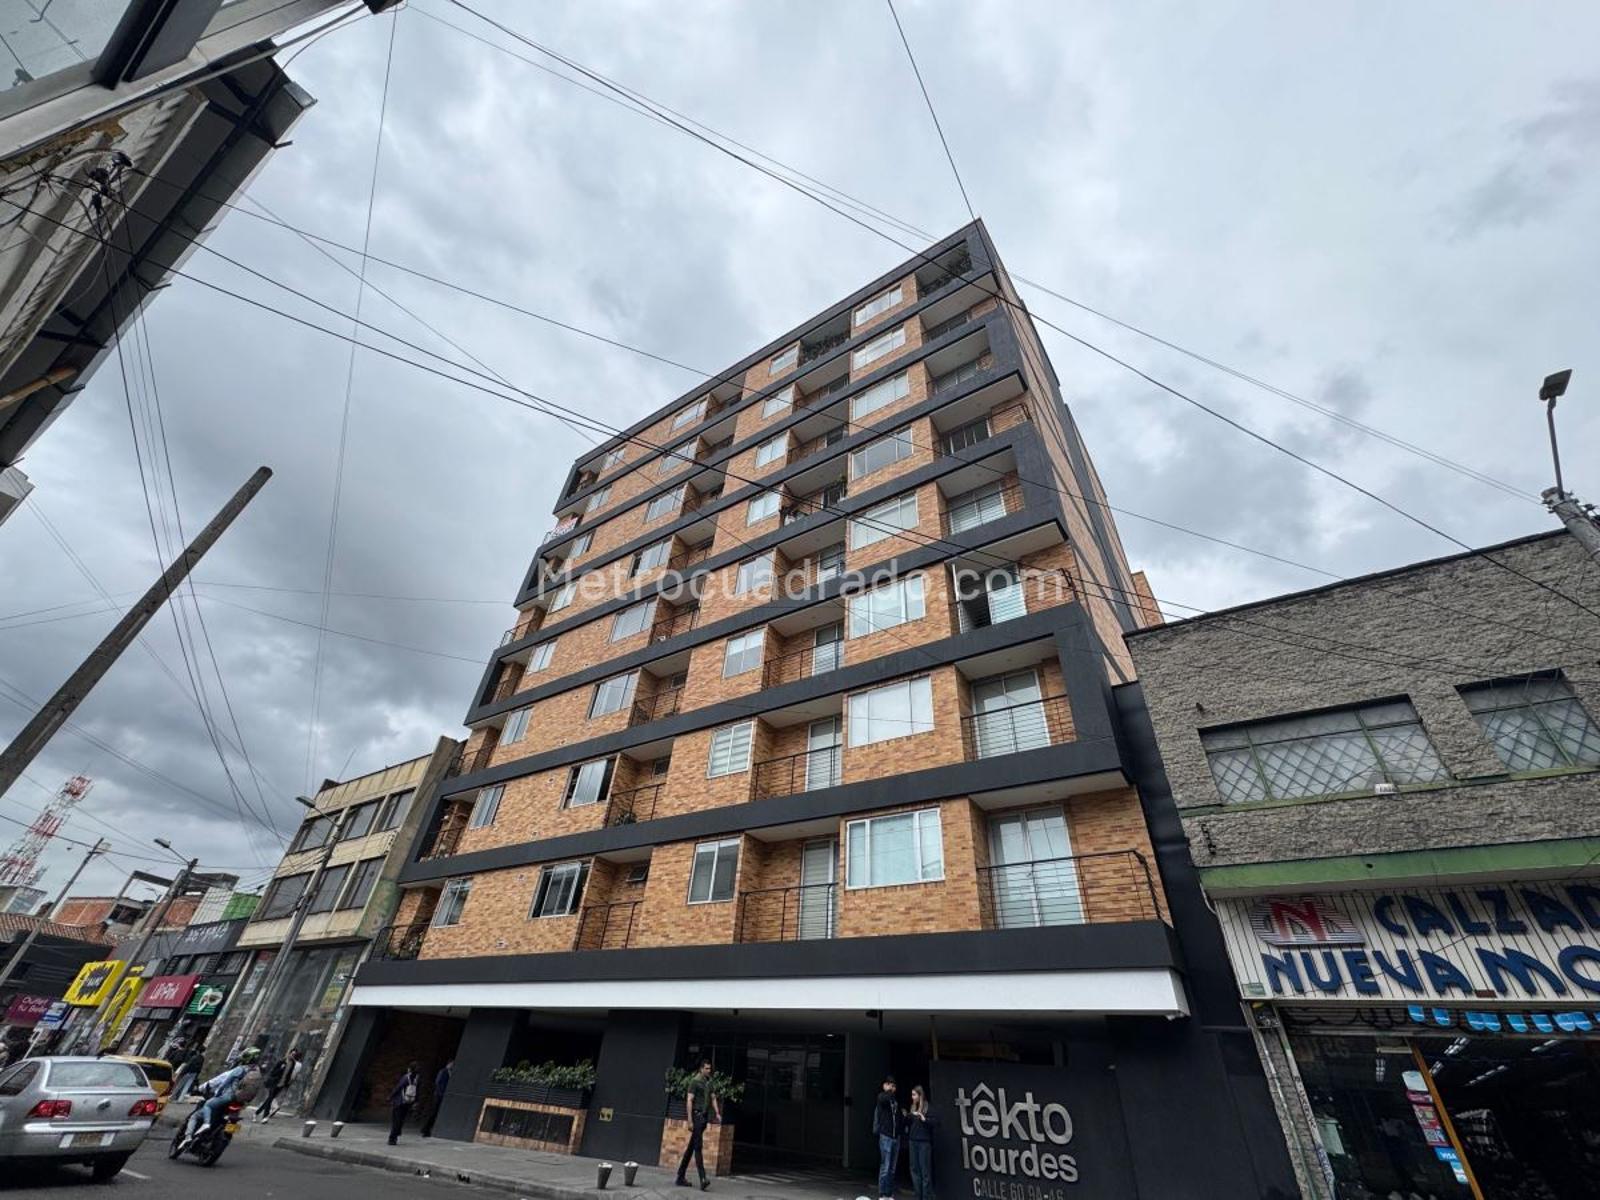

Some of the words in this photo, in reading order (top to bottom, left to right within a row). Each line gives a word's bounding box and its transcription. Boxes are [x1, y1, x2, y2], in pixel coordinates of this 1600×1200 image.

[1262, 950, 1475, 995] NUEVA
[955, 1082, 1073, 1145] têkto
[962, 1138, 1079, 1182] lourdes
[973, 1178, 1007, 1200] CALLE
